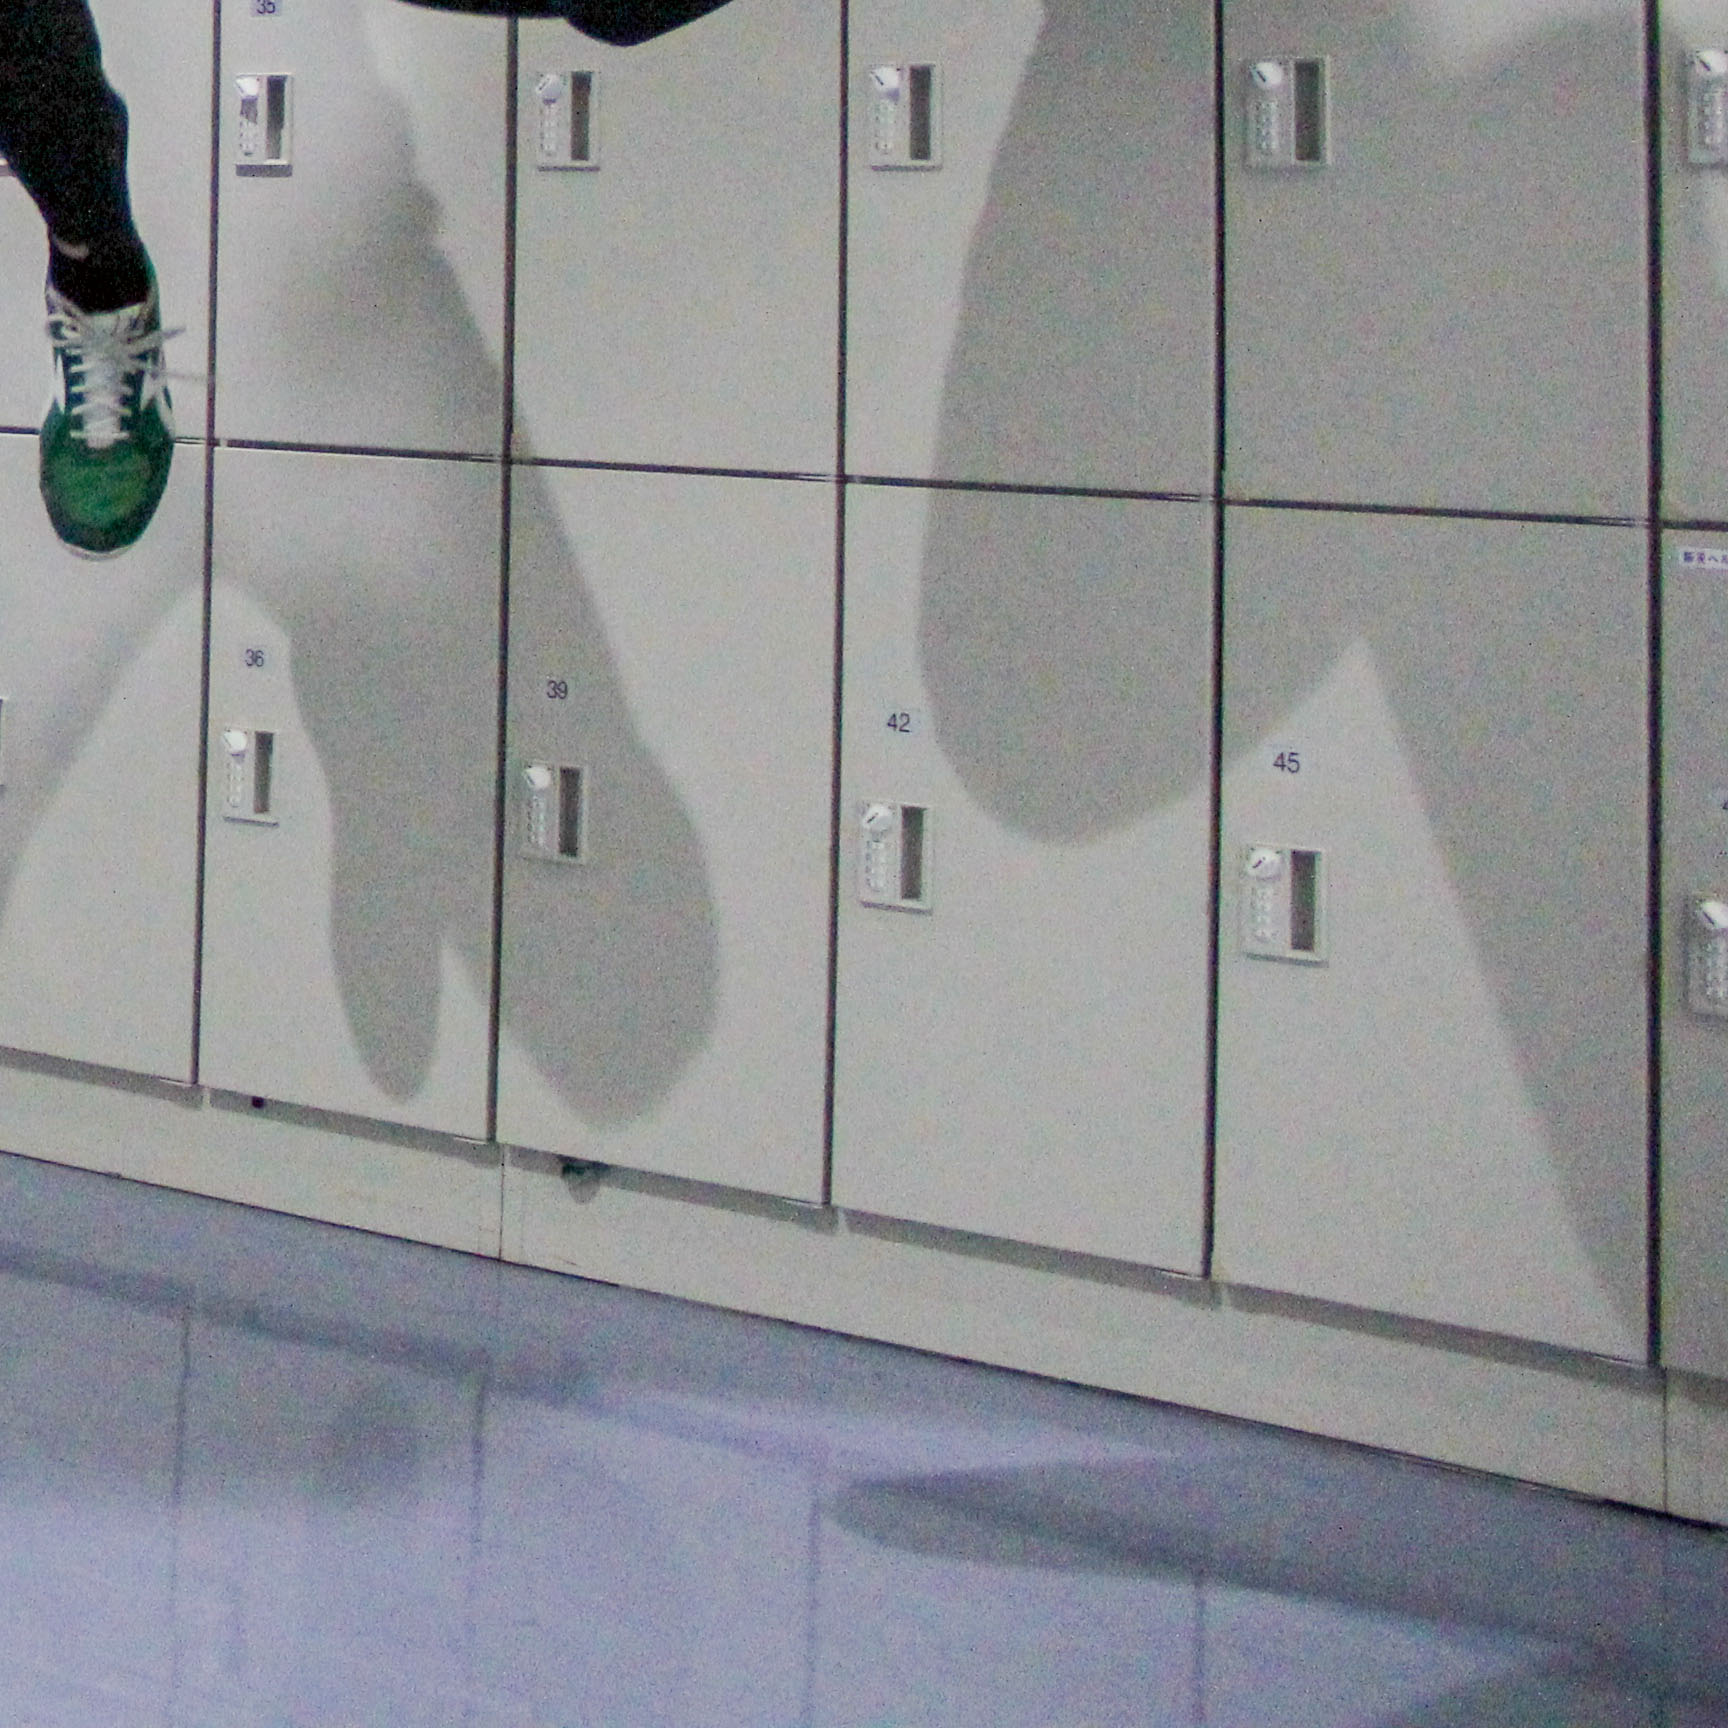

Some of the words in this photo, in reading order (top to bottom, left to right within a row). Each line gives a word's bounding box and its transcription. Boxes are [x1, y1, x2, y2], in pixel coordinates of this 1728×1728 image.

[245, 648, 265, 668] 36
[546, 680, 569, 700] 39
[886, 712, 912, 734] 42
[1272, 751, 1301, 774] 45
